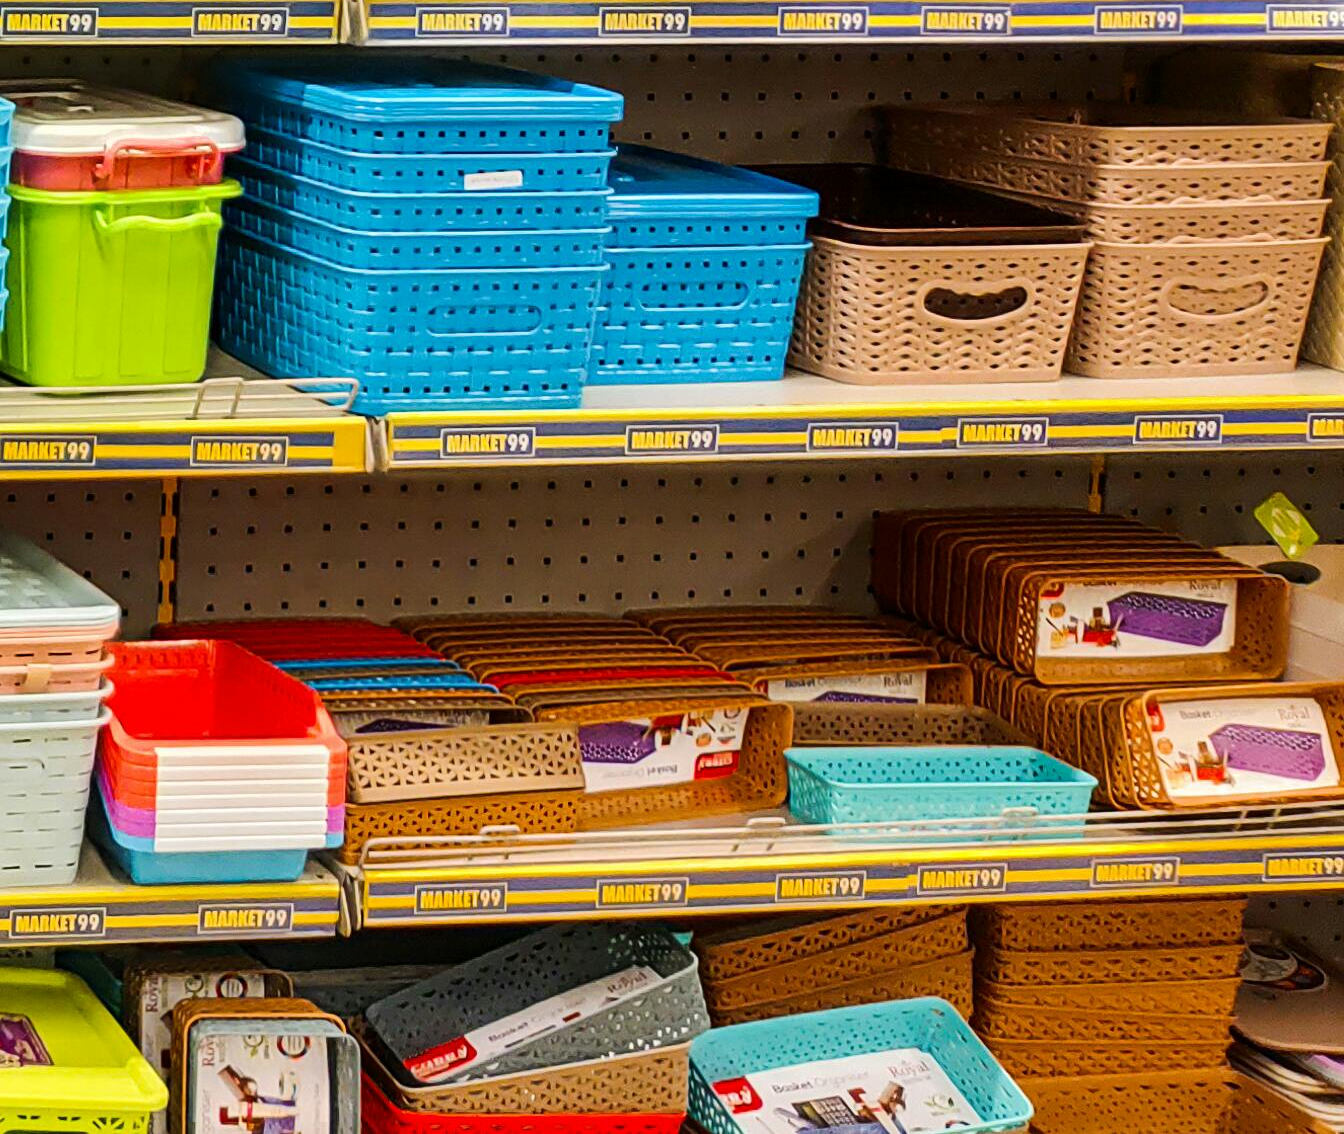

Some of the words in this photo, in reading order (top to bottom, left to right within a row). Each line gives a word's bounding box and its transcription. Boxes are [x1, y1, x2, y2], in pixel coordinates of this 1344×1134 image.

[6, 12, 92, 32] MARKET99
[197, 12, 282, 32] MARKET99
[421, 12, 503, 32] MARKET99
[605, 11, 685, 32] MARKET99
[784, 12, 863, 31] MARKET99
[926, 11, 1004, 30] MARKET99
[1100, 11, 1177, 29] MARKET99
[631, 430, 713, 450] MARKET99
[812, 428, 893, 448] MARKET99
[962, 424, 1043, 444] MARKET99
[1139, 421, 1217, 440] MARKET99
[3, 441, 90, 461] MARKET99
[196, 442, 282, 462] MARKET99
[446, 433, 529, 454] MARKET99
[1096, 861, 1173, 880] MARKET99
[1268, 857, 1343, 875] MARKET99
[781, 877, 860, 897] MARKET99
[923, 868, 1001, 888] MARKET99
[420, 888, 501, 908] MARKET99
[602, 883, 682, 903] MARKET99
[15, 913, 100, 934] MARKET99
[204, 908, 287, 928] MARKET99
